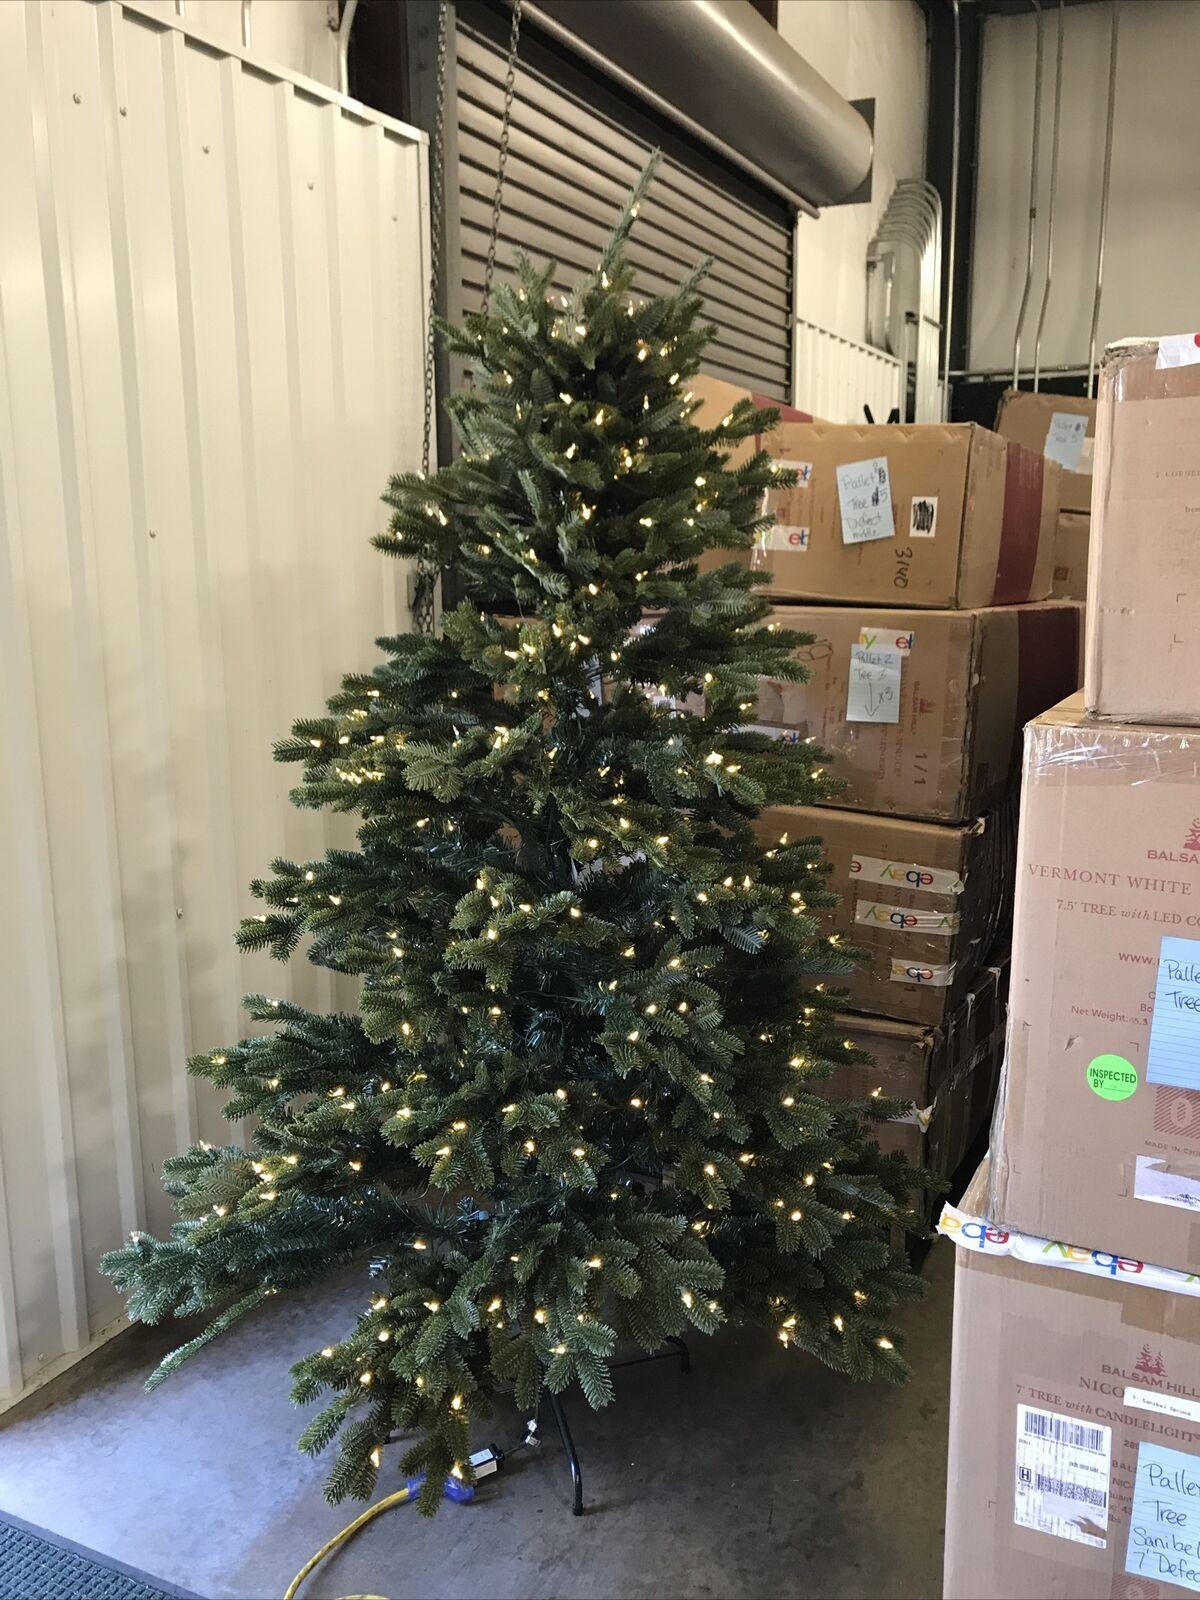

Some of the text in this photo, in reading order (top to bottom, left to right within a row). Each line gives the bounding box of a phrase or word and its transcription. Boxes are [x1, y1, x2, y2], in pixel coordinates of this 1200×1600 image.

[880, 863, 934, 888] ebay
[1028, 863, 1192, 896] VERMONT WHITE
[864, 904, 918, 929] ebay
[1081, 901, 1117, 917] TREE
[1121, 909, 1150, 921] with
[1153, 911, 1182, 925] LED
[1071, 1005, 1089, 1016] Net
[1091, 1008, 1129, 1023] Weight:
[1090, 1068, 1137, 1084] INSPECTED
[1093, 1079, 1104, 1088] BY
[1144, 1140, 1169, 1150] MADE
[1042, 1240, 1144, 1276] ebay
[1101, 1364, 1200, 1398] BALSAM HILL
[1028, 1387, 1062, 1406] TREE
[1065, 1401, 1092, 1415] with
[1142, 1500, 1188, 1527] Tree
